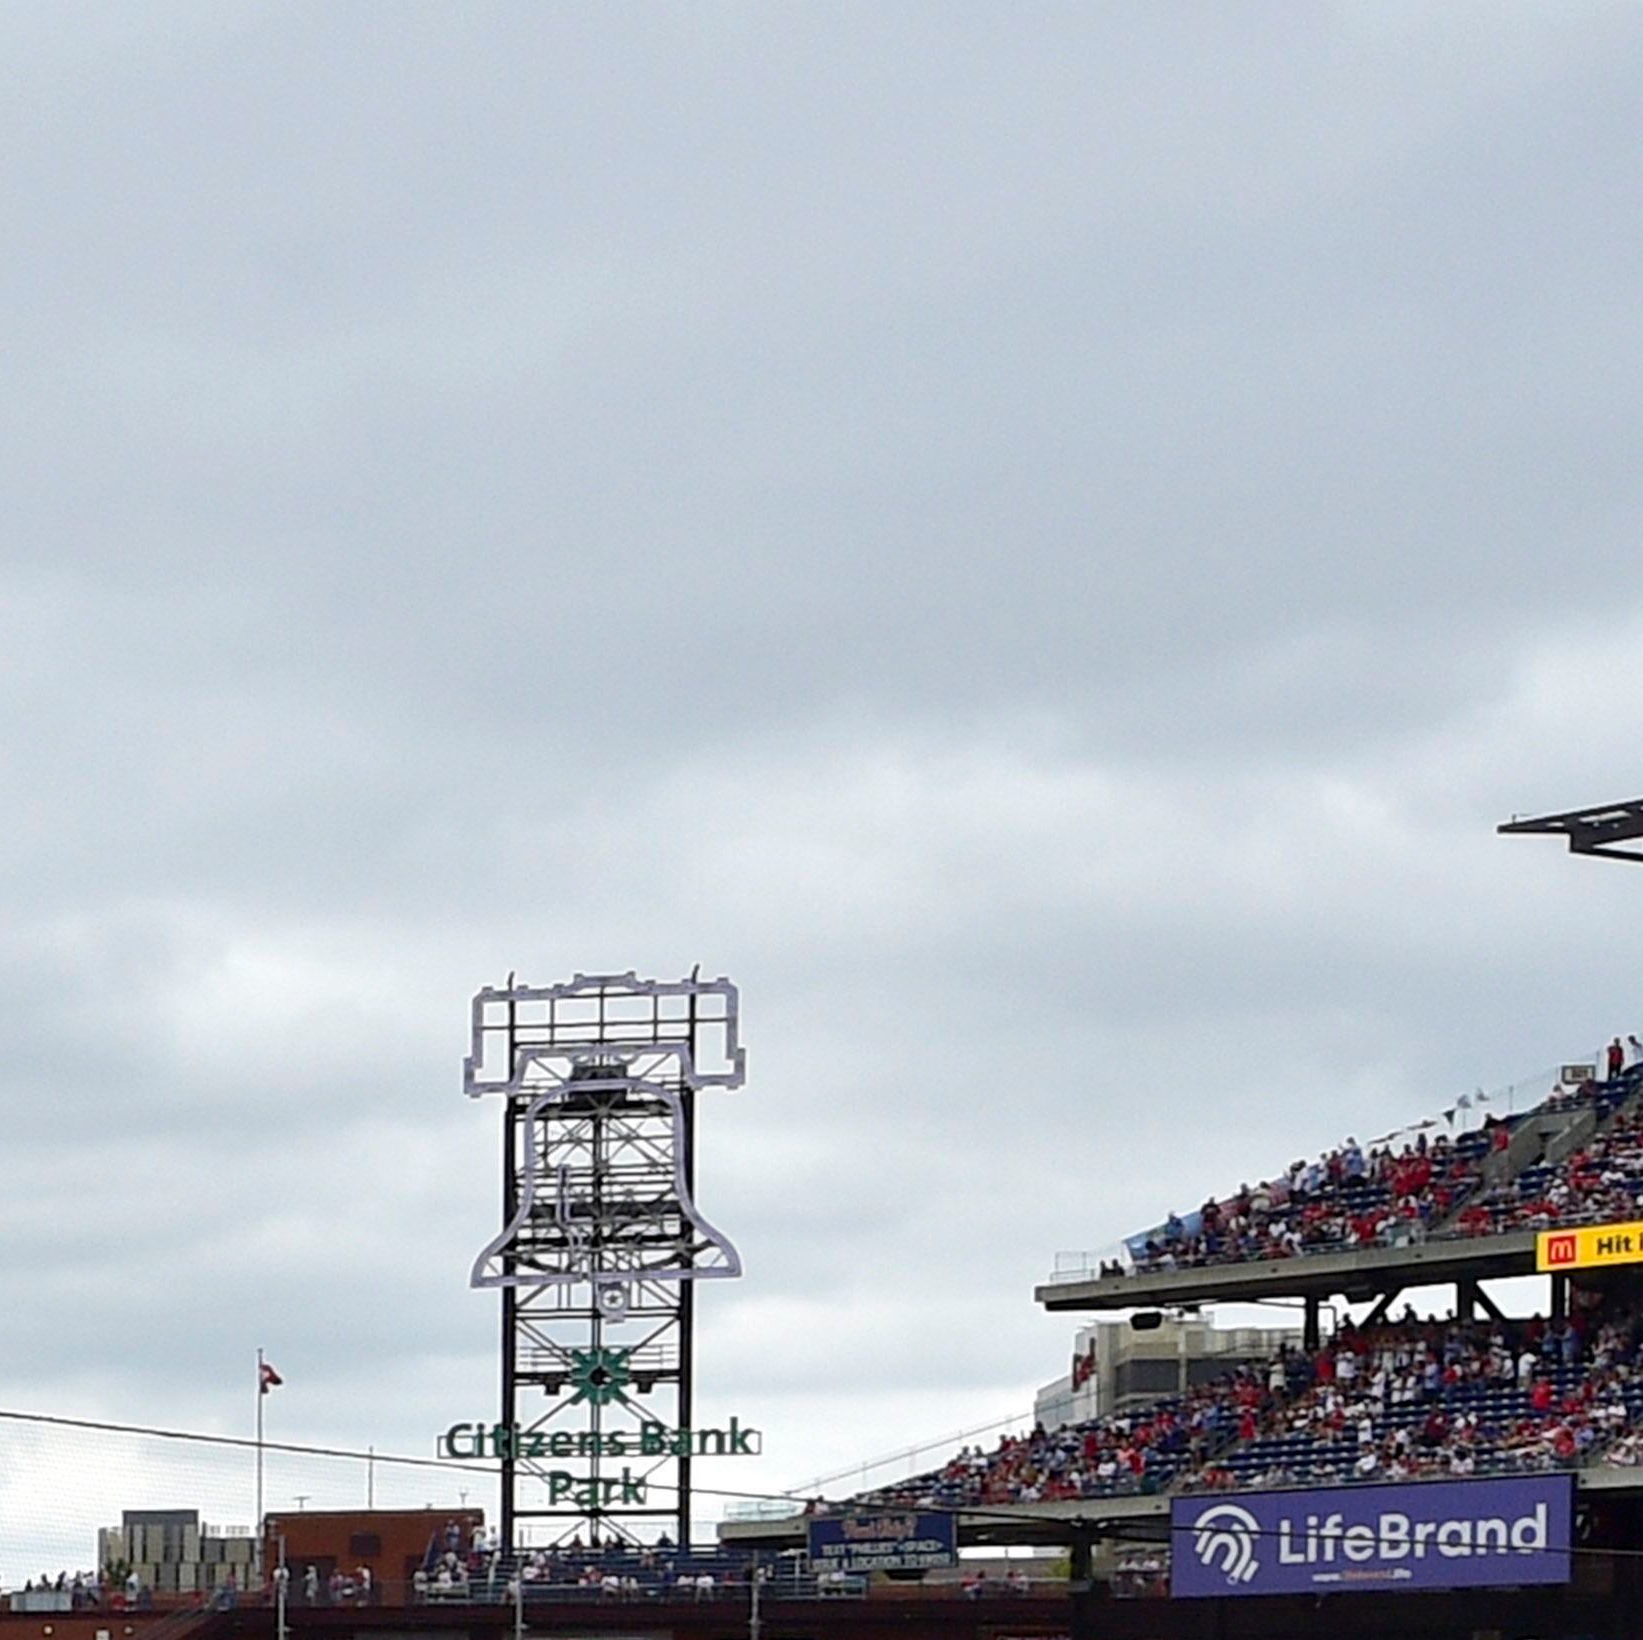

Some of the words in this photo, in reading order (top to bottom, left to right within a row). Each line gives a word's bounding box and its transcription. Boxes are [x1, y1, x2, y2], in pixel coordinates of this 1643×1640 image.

[1596, 1235, 1633, 1256] Hit
[445, 1424, 627, 1459] Citizens
[641, 1416, 753, 1456] Bank
[549, 1467, 647, 1506] Park
[1280, 1502, 1548, 1564] LifeBrand
